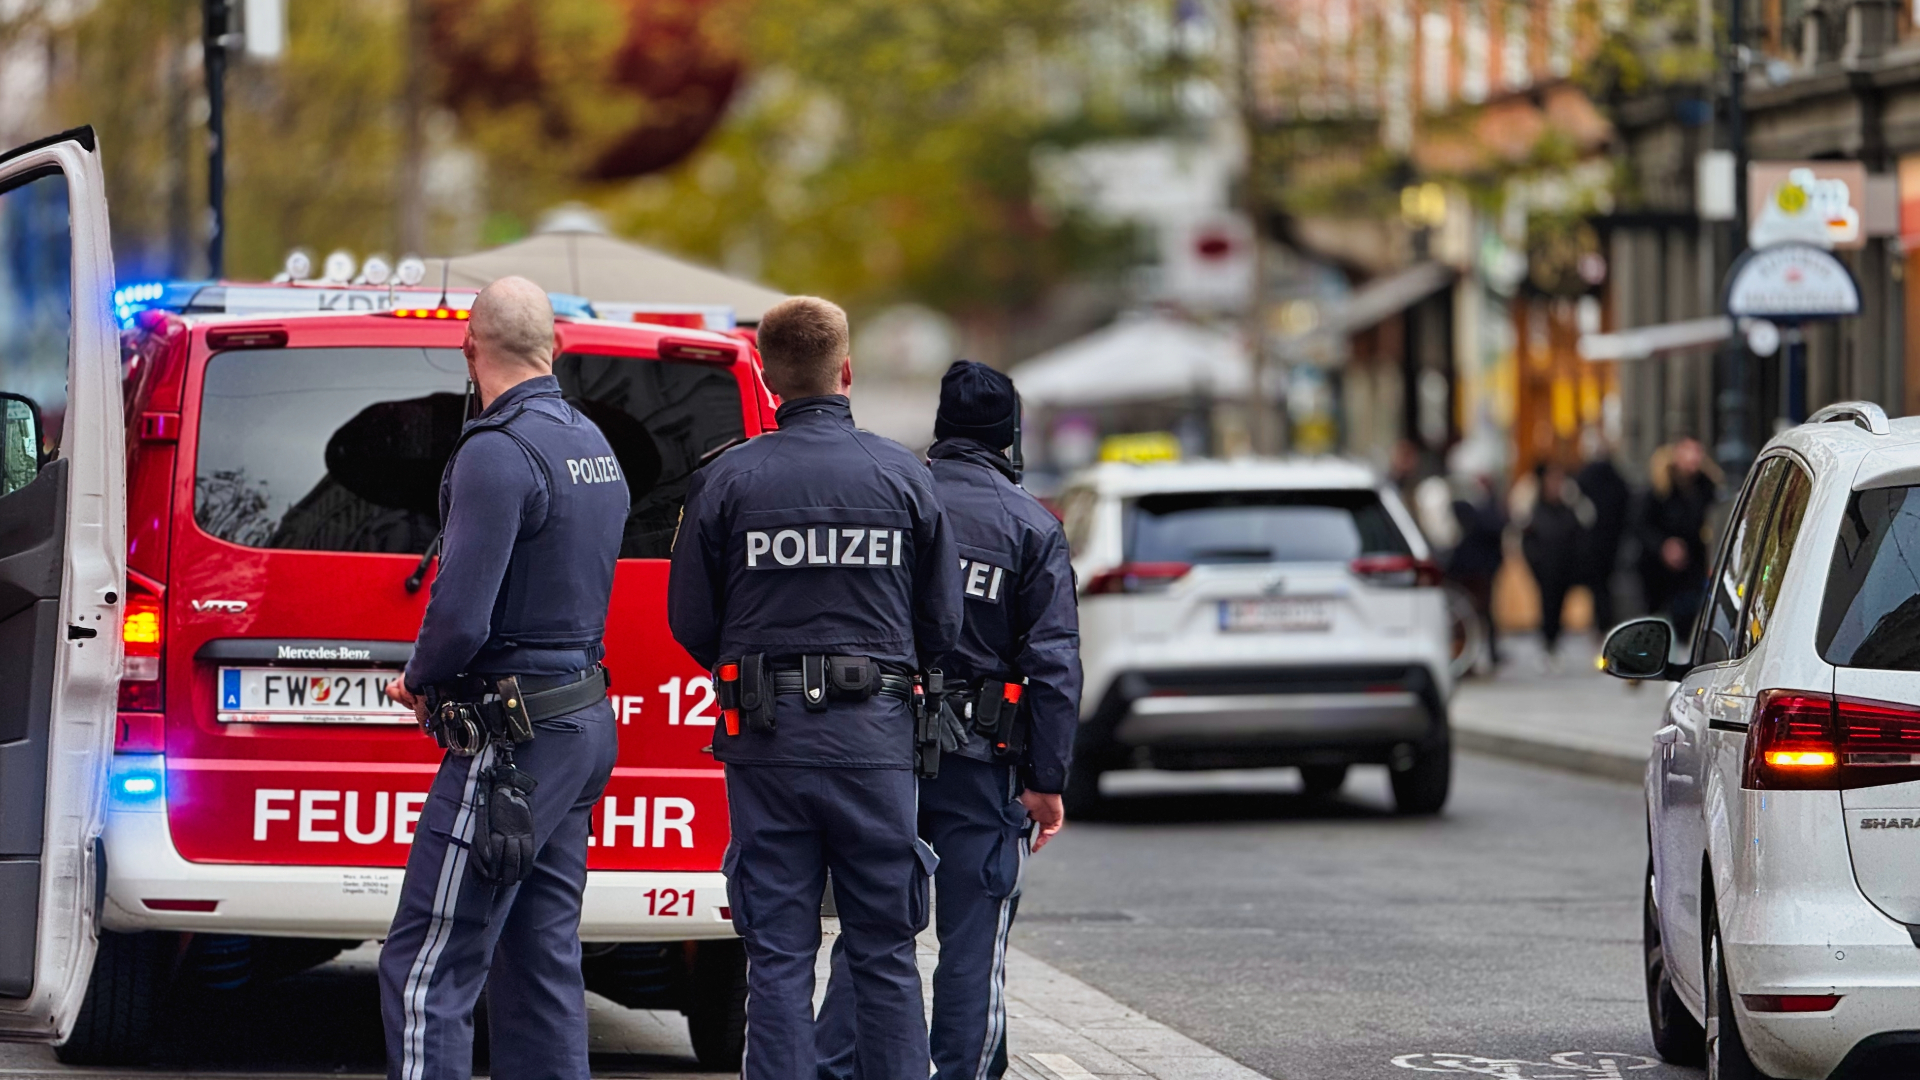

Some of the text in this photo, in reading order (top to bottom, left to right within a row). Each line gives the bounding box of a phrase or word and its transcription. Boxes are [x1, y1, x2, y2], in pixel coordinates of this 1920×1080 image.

[566, 456, 621, 485] POLIZEI
[746, 528, 903, 567] POLIZEI
[191, 599, 249, 613] VITO
[277, 645, 371, 660] Mercedes-Benz
[227, 693, 237, 705] A
[264, 675, 308, 706] FW
[334, 676, 367, 707] 21
[642, 888, 695, 917] 121
